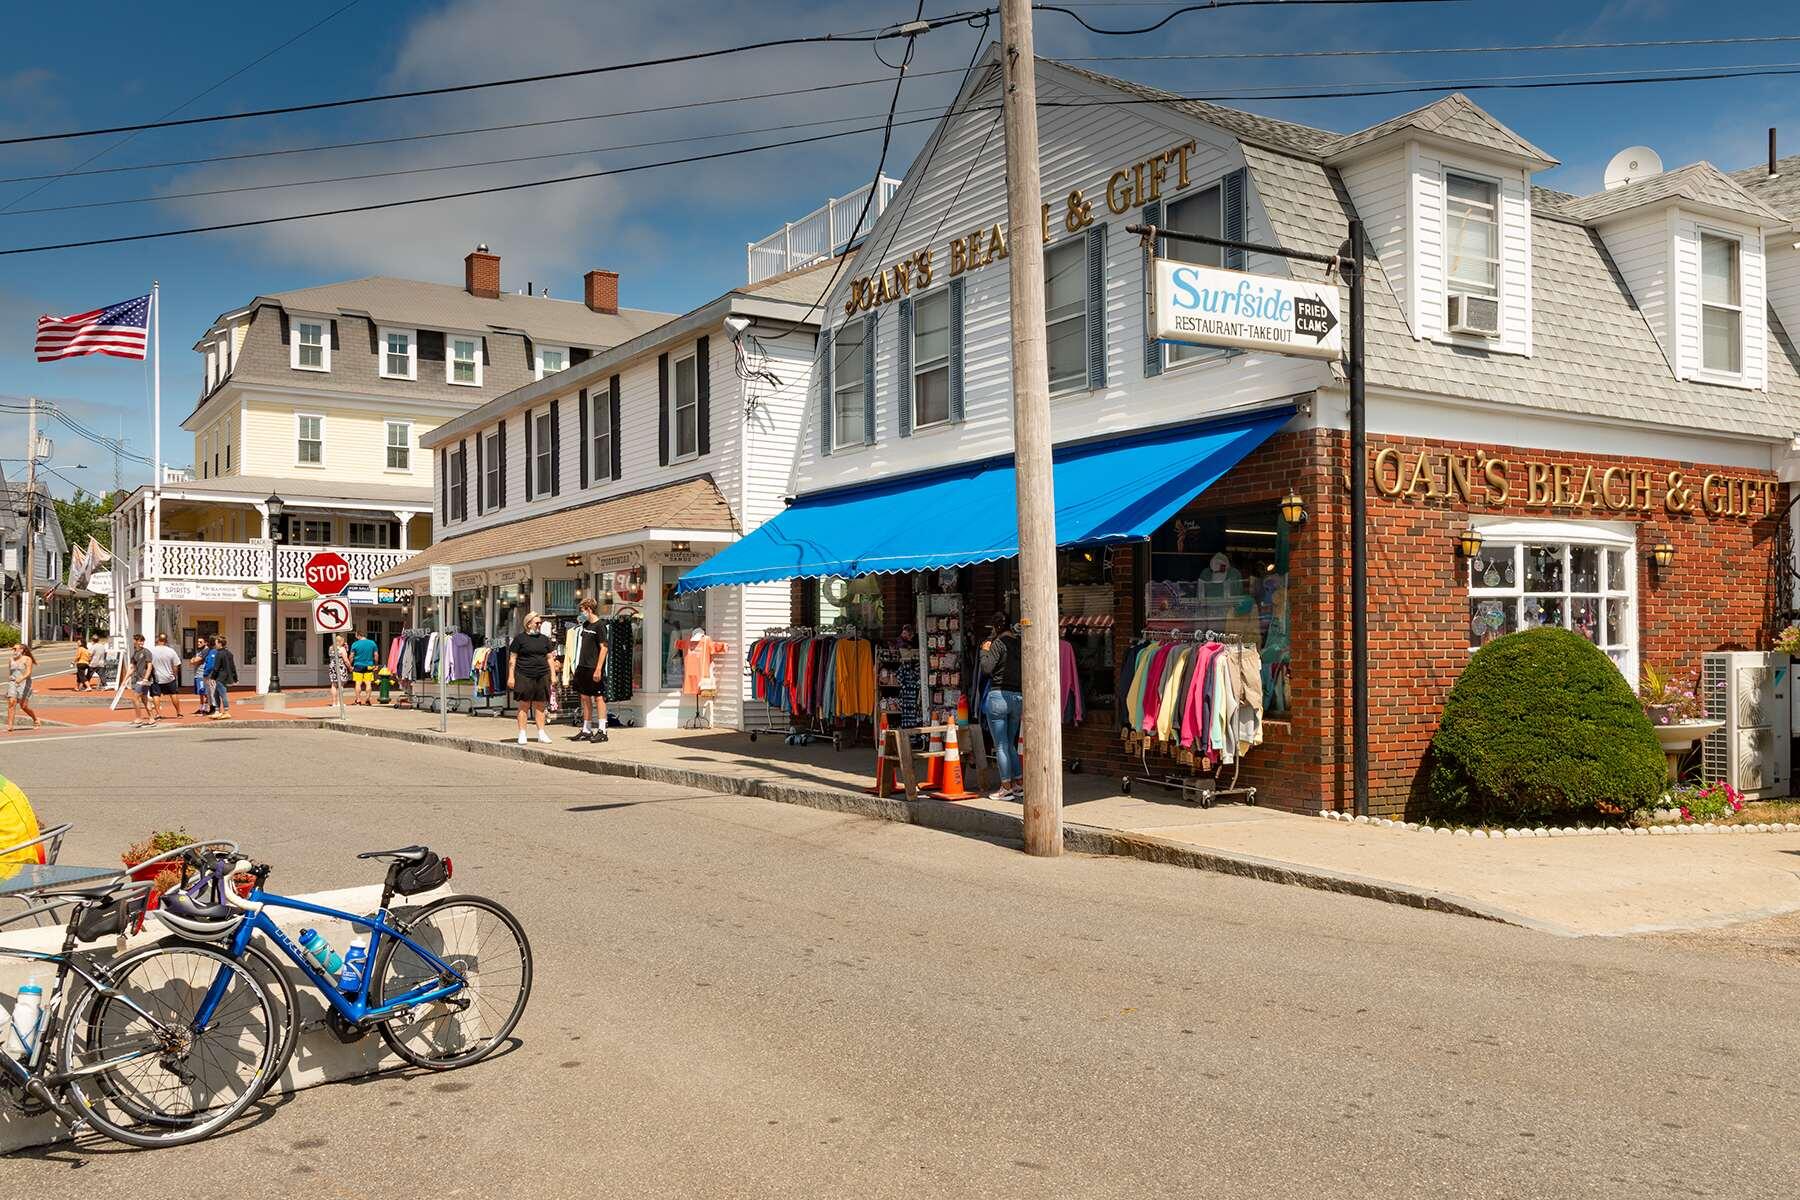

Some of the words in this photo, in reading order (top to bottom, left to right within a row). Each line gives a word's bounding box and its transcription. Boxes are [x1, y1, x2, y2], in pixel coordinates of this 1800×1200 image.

[845, 250, 934, 316] JOAN'S
[949, 203, 1050, 277] BEA
[1066, 190, 1095, 232] &
[1106, 139, 1197, 214] GIFT
[1172, 267, 1293, 322] Surfside
[1298, 302, 1328, 318] FRIED
[1296, 317, 1328, 334] CLAMS
[1526, 461, 1653, 510] BEACH
[1665, 471, 1696, 514] &
[1703, 473, 1779, 518] GIFT
[308, 564, 347, 583] STOP
[395, 588, 413, 600] SAND
